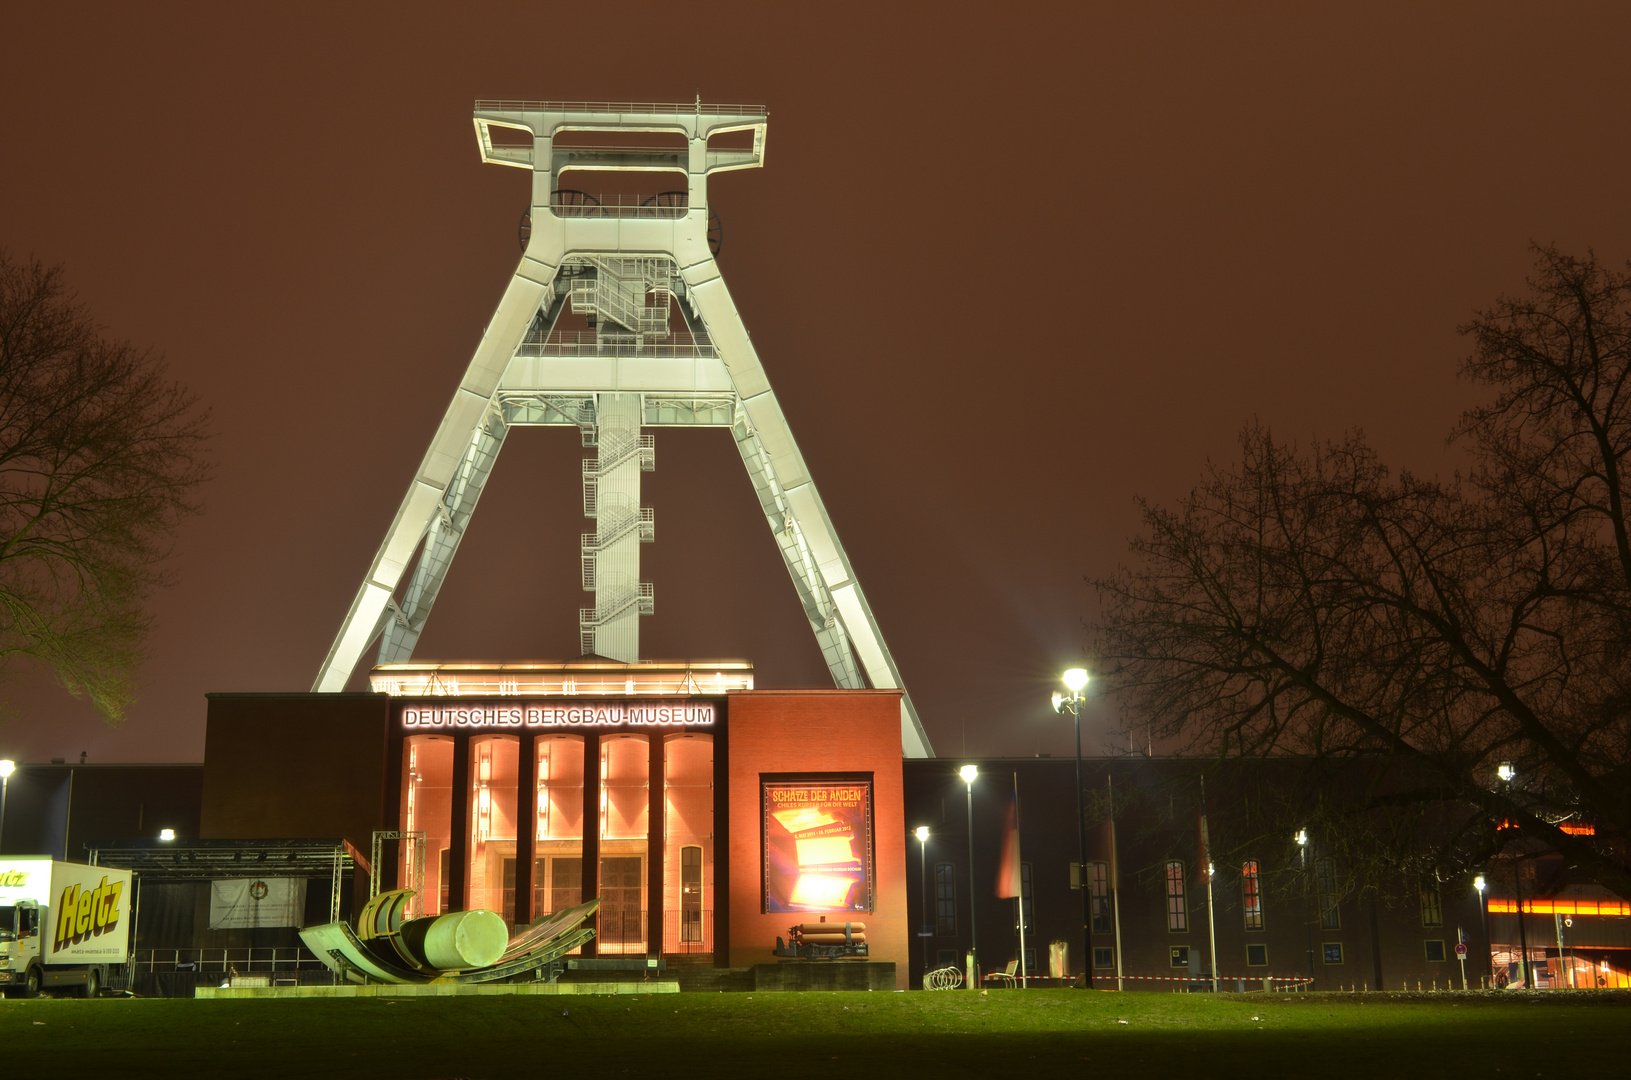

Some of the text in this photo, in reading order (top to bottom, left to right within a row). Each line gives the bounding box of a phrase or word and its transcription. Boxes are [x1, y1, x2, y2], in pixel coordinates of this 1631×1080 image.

[404, 706, 713, 727] DEUTSCHES BERGBAU-MUSEUM
[773, 789, 861, 802] SCHÄTZE DER ANDEN
[0, 869, 31, 887] rtz
[53, 876, 123, 953] Hertz
